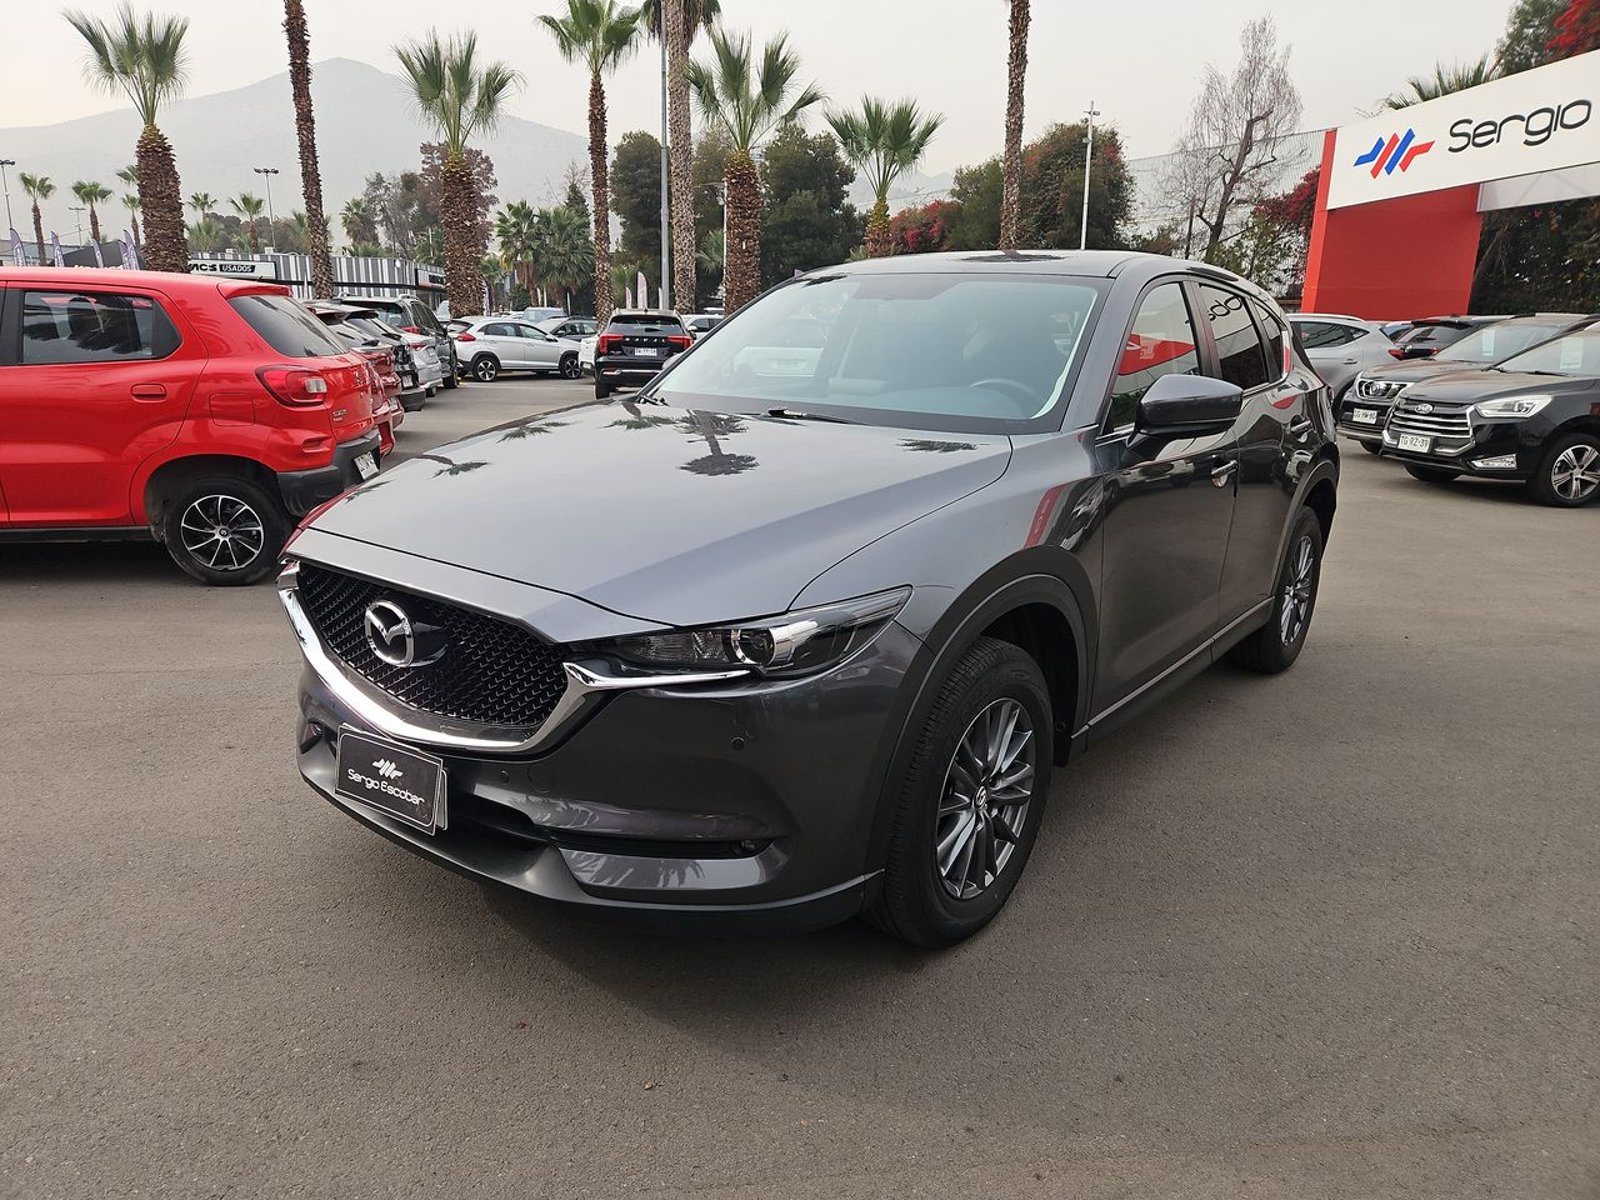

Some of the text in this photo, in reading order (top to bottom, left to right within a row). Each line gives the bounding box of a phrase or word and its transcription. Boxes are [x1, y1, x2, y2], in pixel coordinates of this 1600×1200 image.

[1448, 99, 1592, 153] Sergio
[222, 264, 252, 272] USADOS
[380, 780, 425, 806] Escobar
